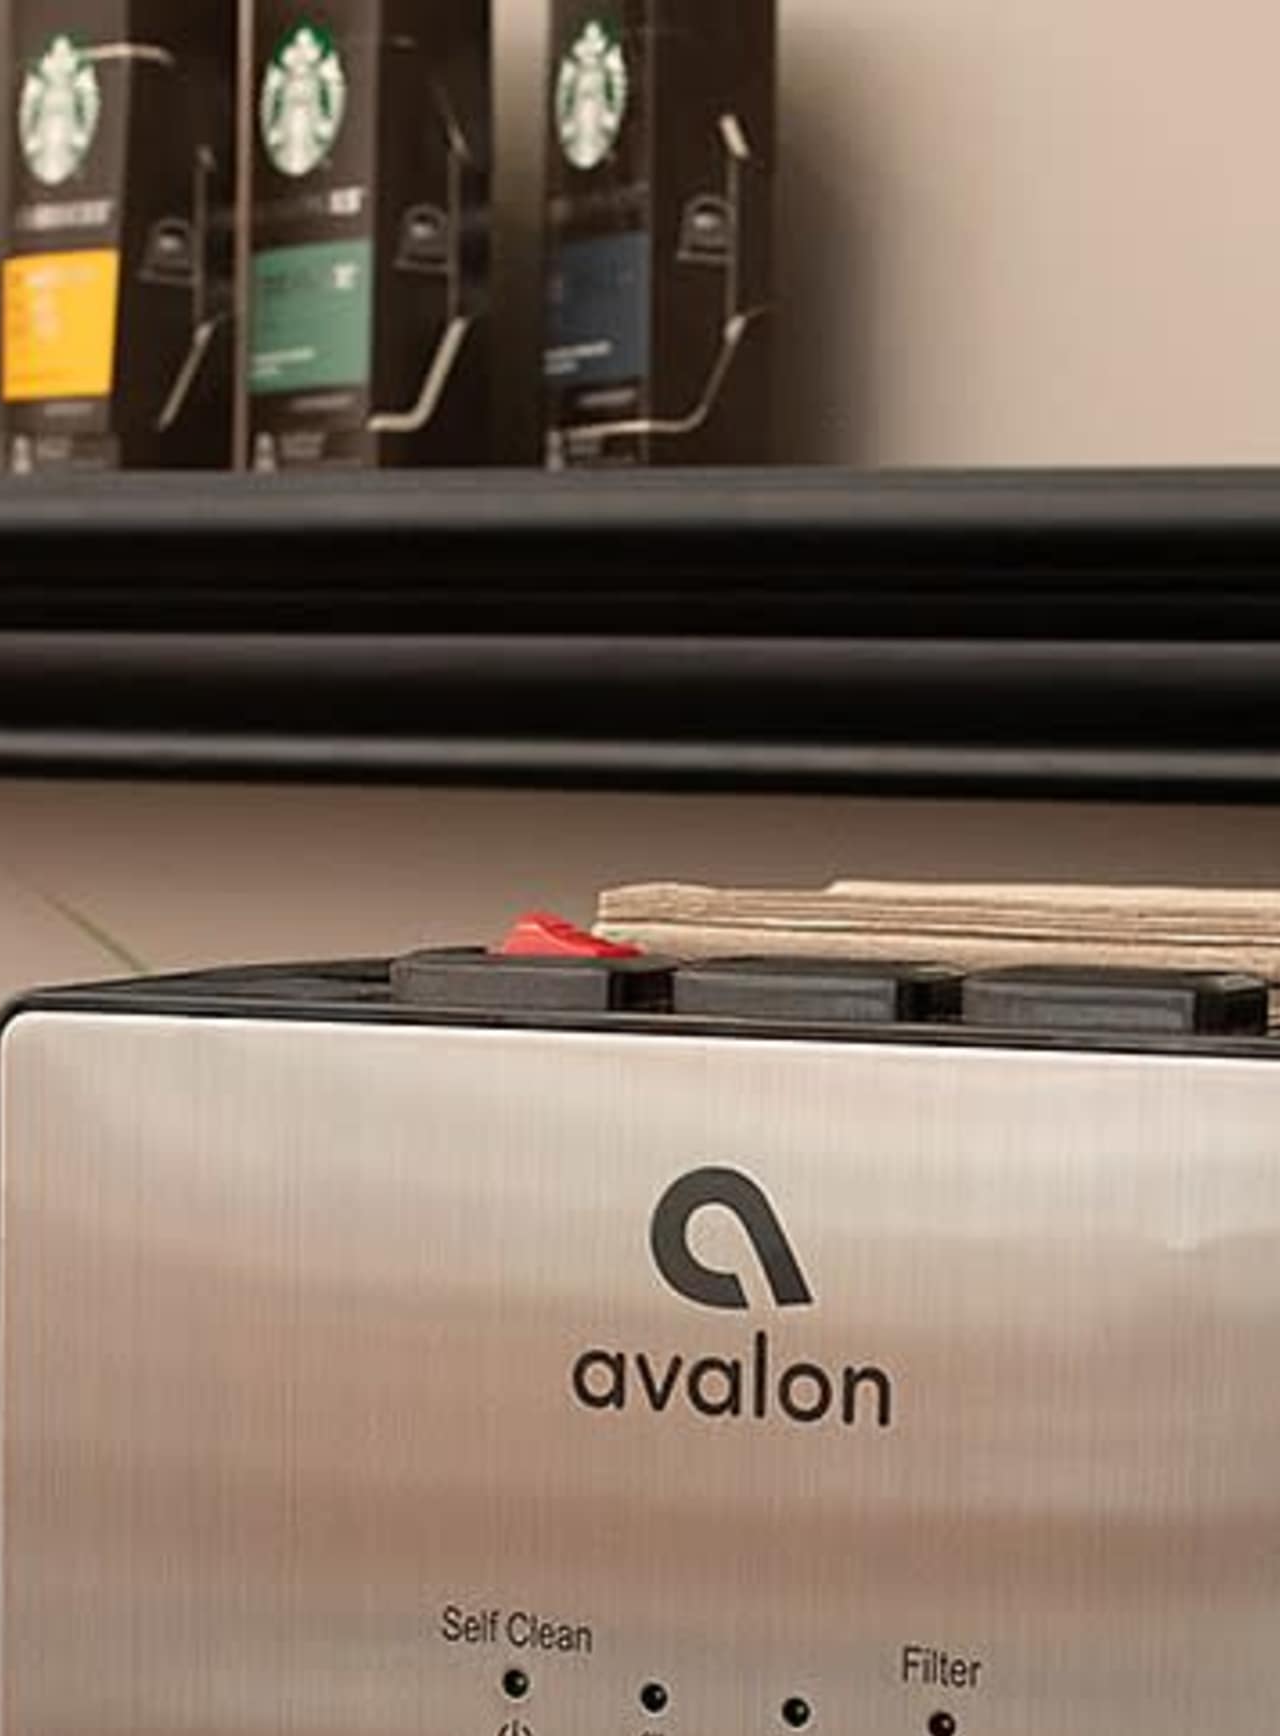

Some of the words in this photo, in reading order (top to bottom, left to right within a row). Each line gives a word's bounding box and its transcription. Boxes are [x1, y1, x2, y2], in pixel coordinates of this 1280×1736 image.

[573, 1331, 891, 1427] avalon
[441, 1606, 501, 1645] Self
[505, 1610, 593, 1653] Clean
[901, 1645, 982, 1688] Filter
